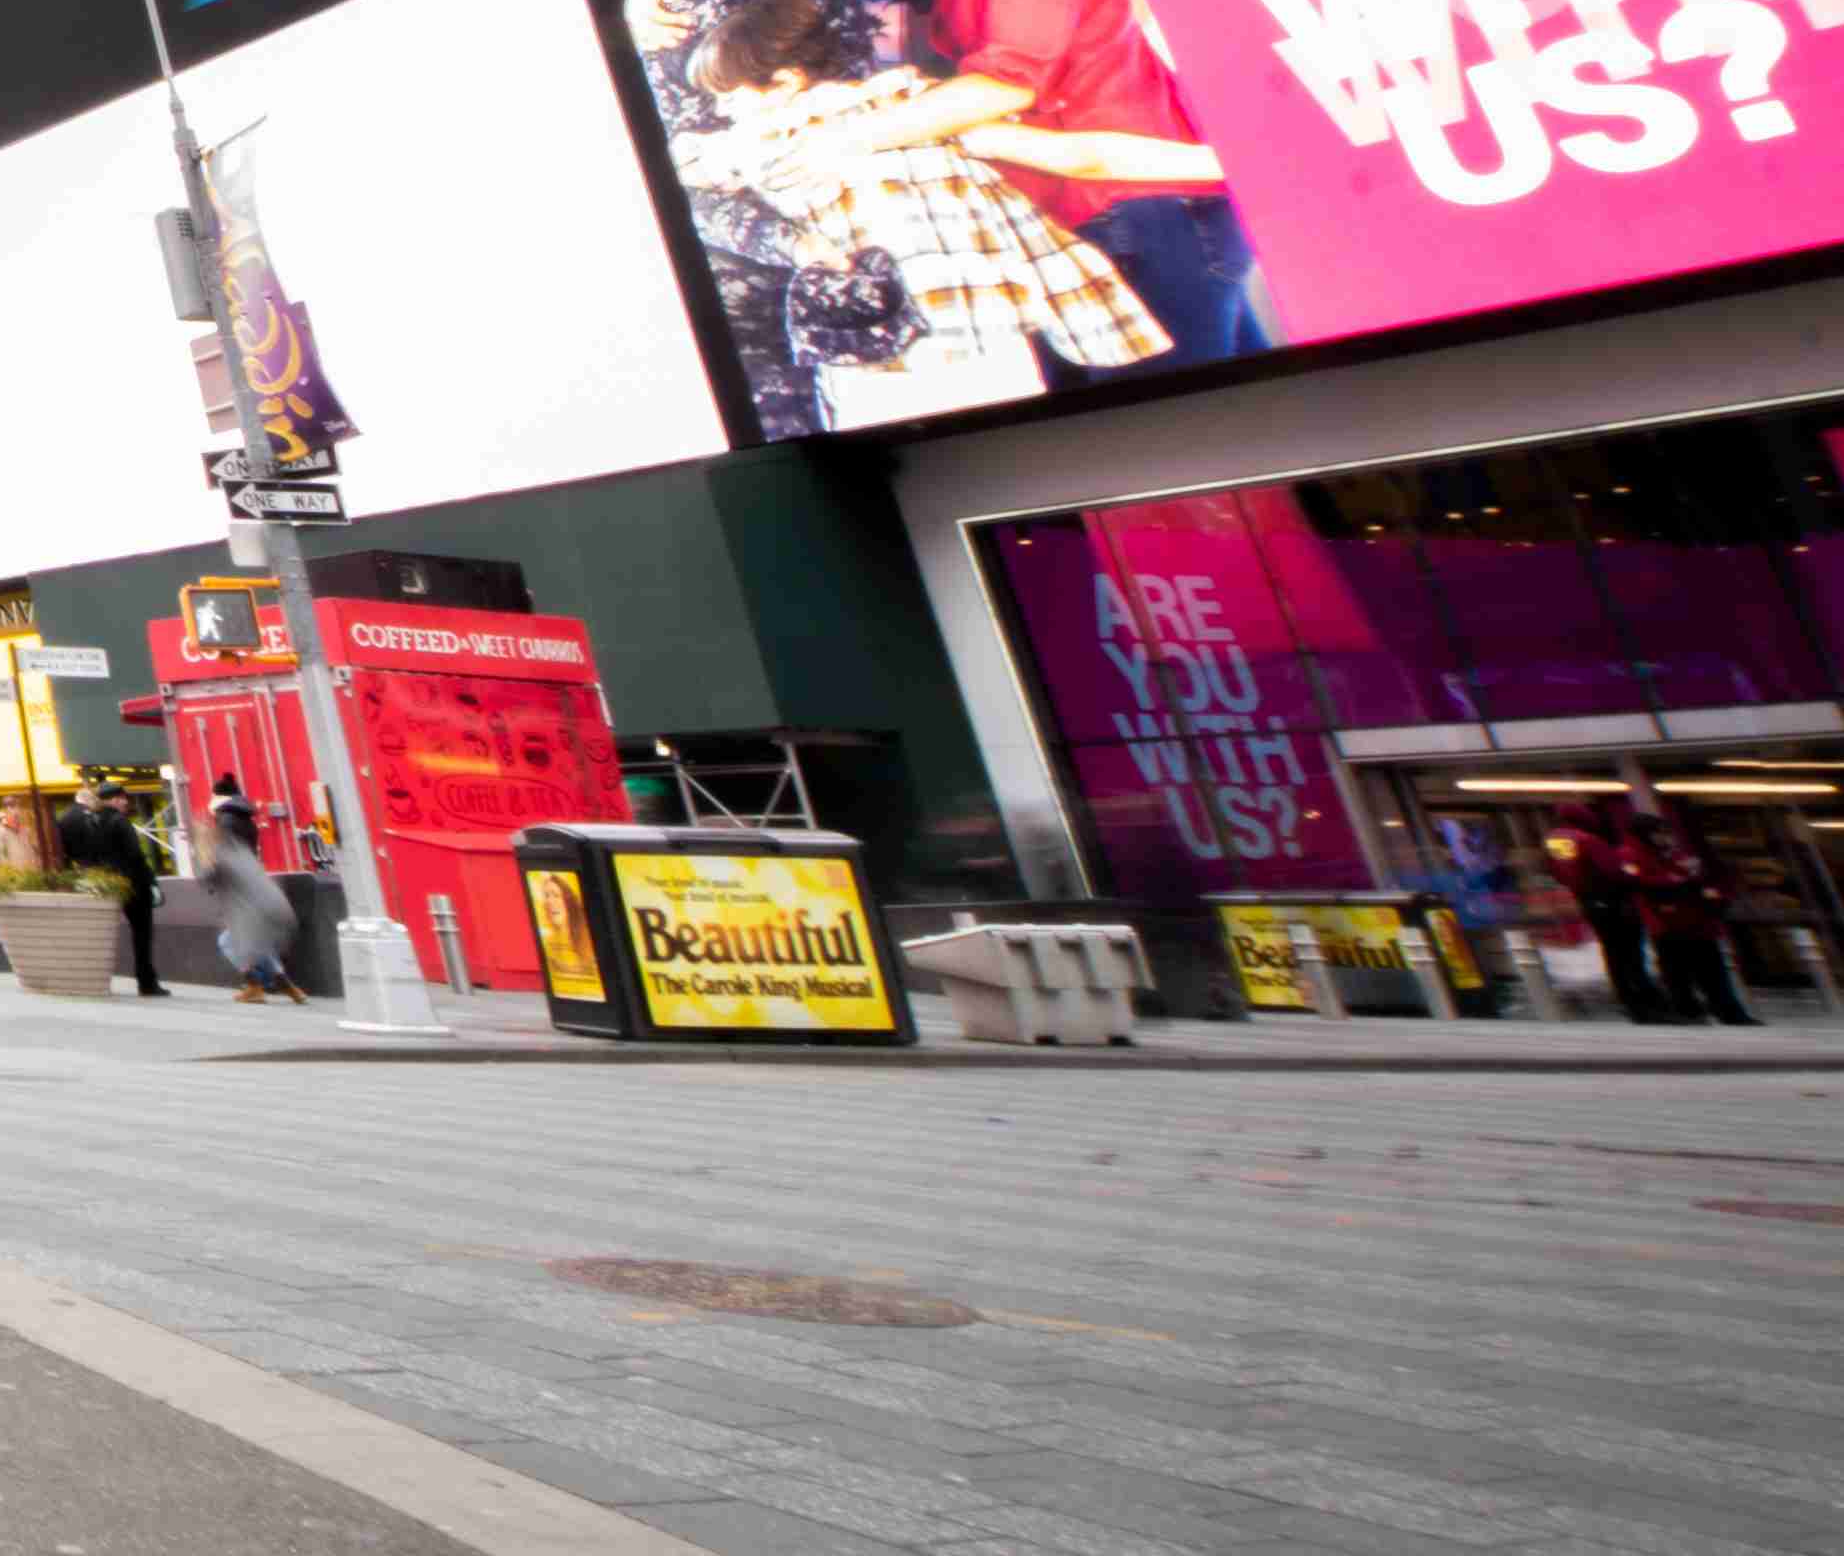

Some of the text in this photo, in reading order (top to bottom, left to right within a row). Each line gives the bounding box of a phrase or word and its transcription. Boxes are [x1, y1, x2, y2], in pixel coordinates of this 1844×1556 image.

[243, 491, 330, 511] ONE WAY
[351, 621, 460, 655] COFFEED
[1095, 574, 1235, 642] ARE
[1100, 642, 1260, 715] YOU
[1111, 714, 1306, 788] WITH
[1165, 785, 1305, 862] US?
[634, 906, 867, 967] Beautiful
[648, 971, 877, 1002] The Carole King Musical
